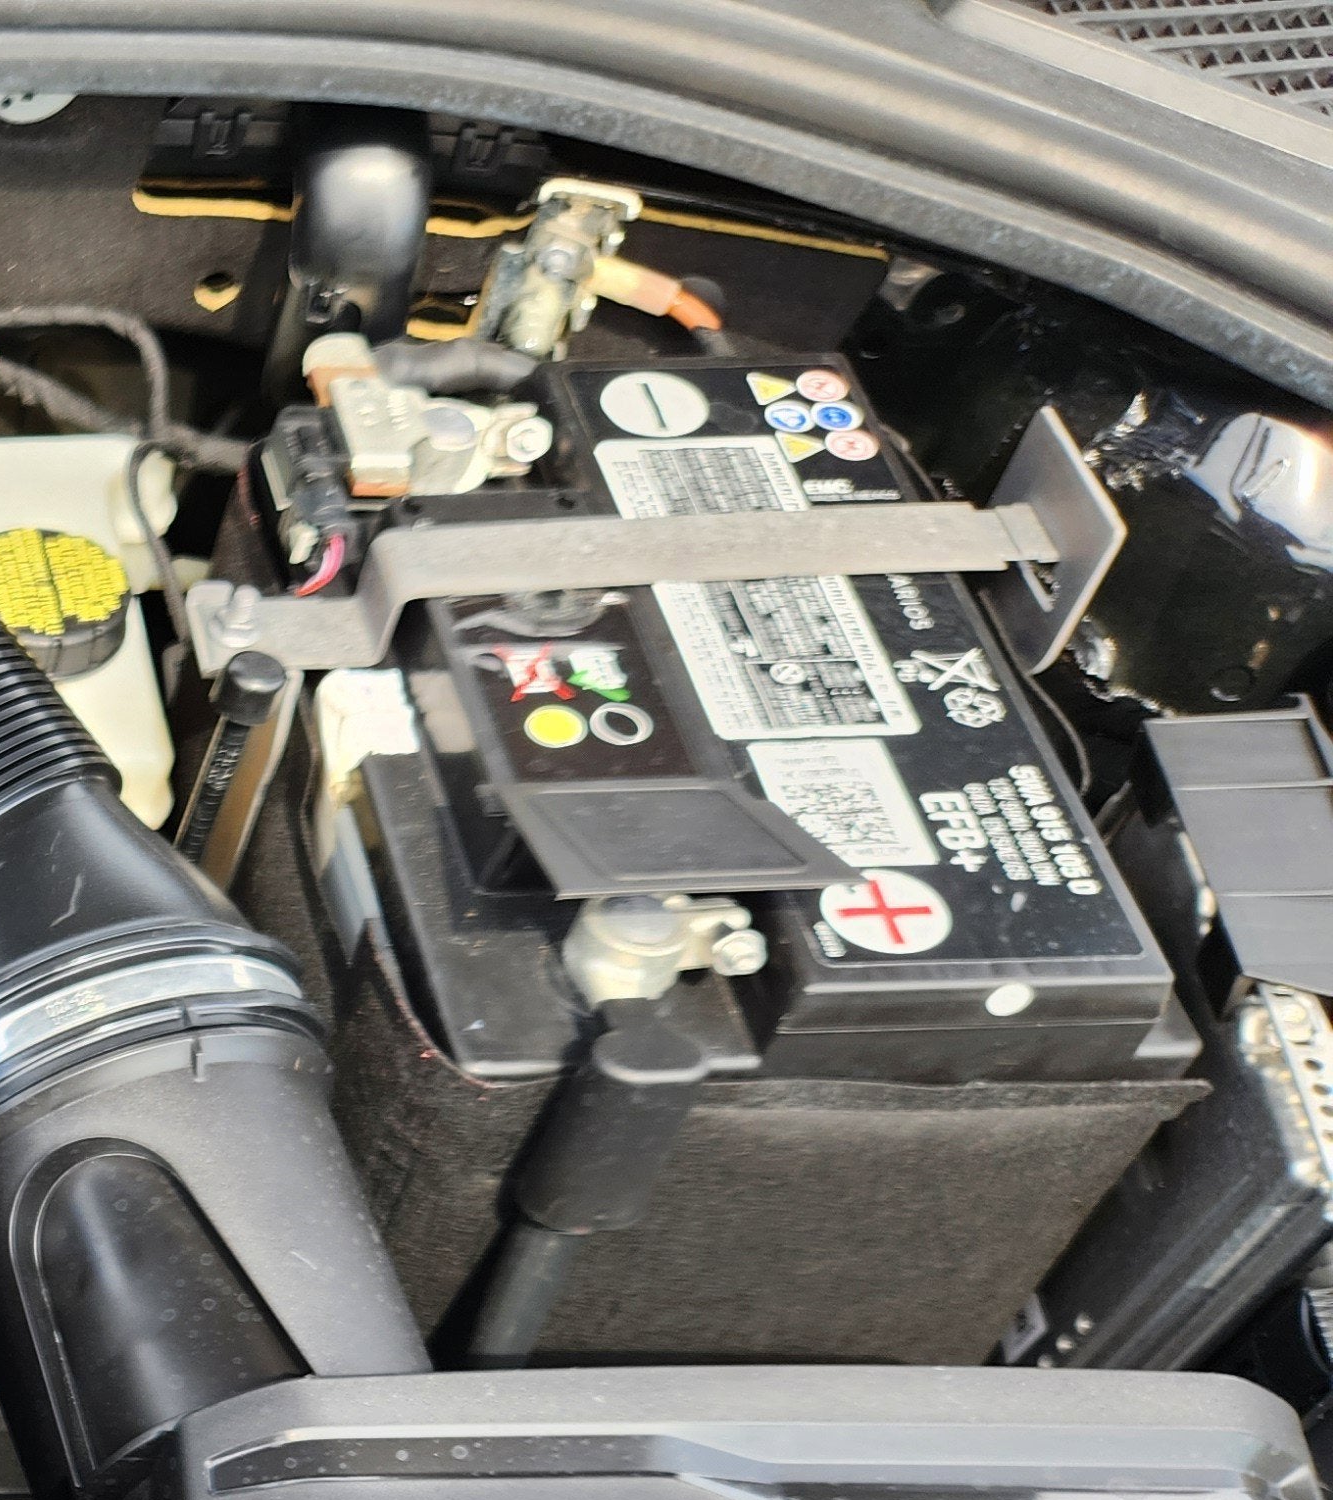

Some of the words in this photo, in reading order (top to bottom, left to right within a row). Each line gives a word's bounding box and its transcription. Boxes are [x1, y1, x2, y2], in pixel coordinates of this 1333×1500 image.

[919, 791, 989, 873] EFB+
[1029, 804, 1073, 842] 915
[1049, 843, 1093, 878] 105
